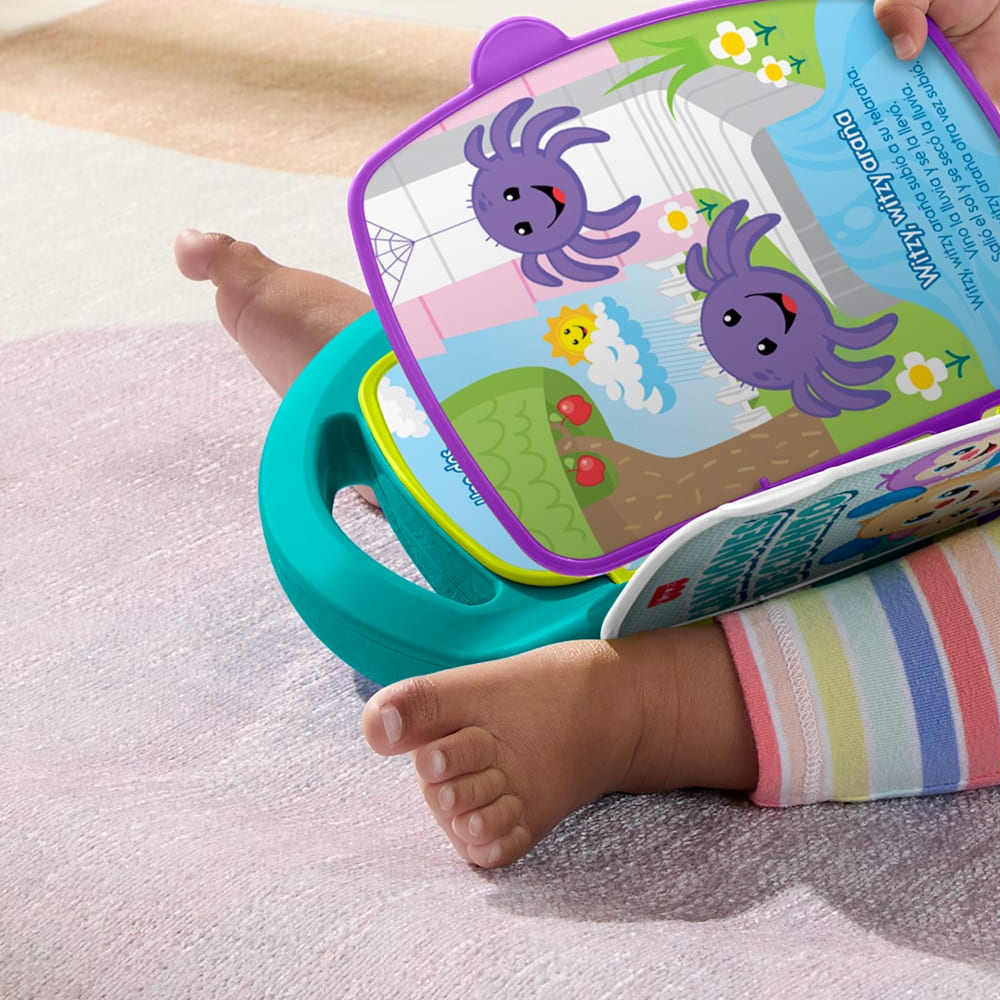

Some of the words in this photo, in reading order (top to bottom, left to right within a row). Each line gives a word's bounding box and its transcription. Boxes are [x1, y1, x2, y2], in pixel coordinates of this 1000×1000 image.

[846, 65, 884, 126] telaraña.
[908, 60, 938, 99] subió.
[885, 100, 913, 136] llevó.
[901, 82, 927, 121] lluvia.
[931, 98, 950, 123] vez
[832, 108, 880, 174] araña
[877, 126, 894, 143] su
[905, 135, 921, 152] la
[920, 120, 936, 137] la
[944, 122, 967, 151] otra
[887, 143, 900, 154] a
[915, 150, 930, 167] se
[926, 135, 953, 167] secó
[891, 155, 921, 191] subió
[923, 167, 939, 177] y
[947, 167, 963, 183] se
[961, 152, 990, 193] araña
[865, 169, 909, 228] witzy
[929, 176, 955, 213] lluvia
[955, 184, 971, 194] y
[957, 193, 979, 213] sol
[914, 191, 944, 233] araña
[948, 211, 964, 228] la
[969, 213, 987, 227] el
[896, 222, 942, 291] Witzy,
[937, 234, 963, 269] witzy
[958, 227, 979, 260] Vino
[957, 268, 986, 311] Witzy,
[757, 495, 849, 574] CUENTO
